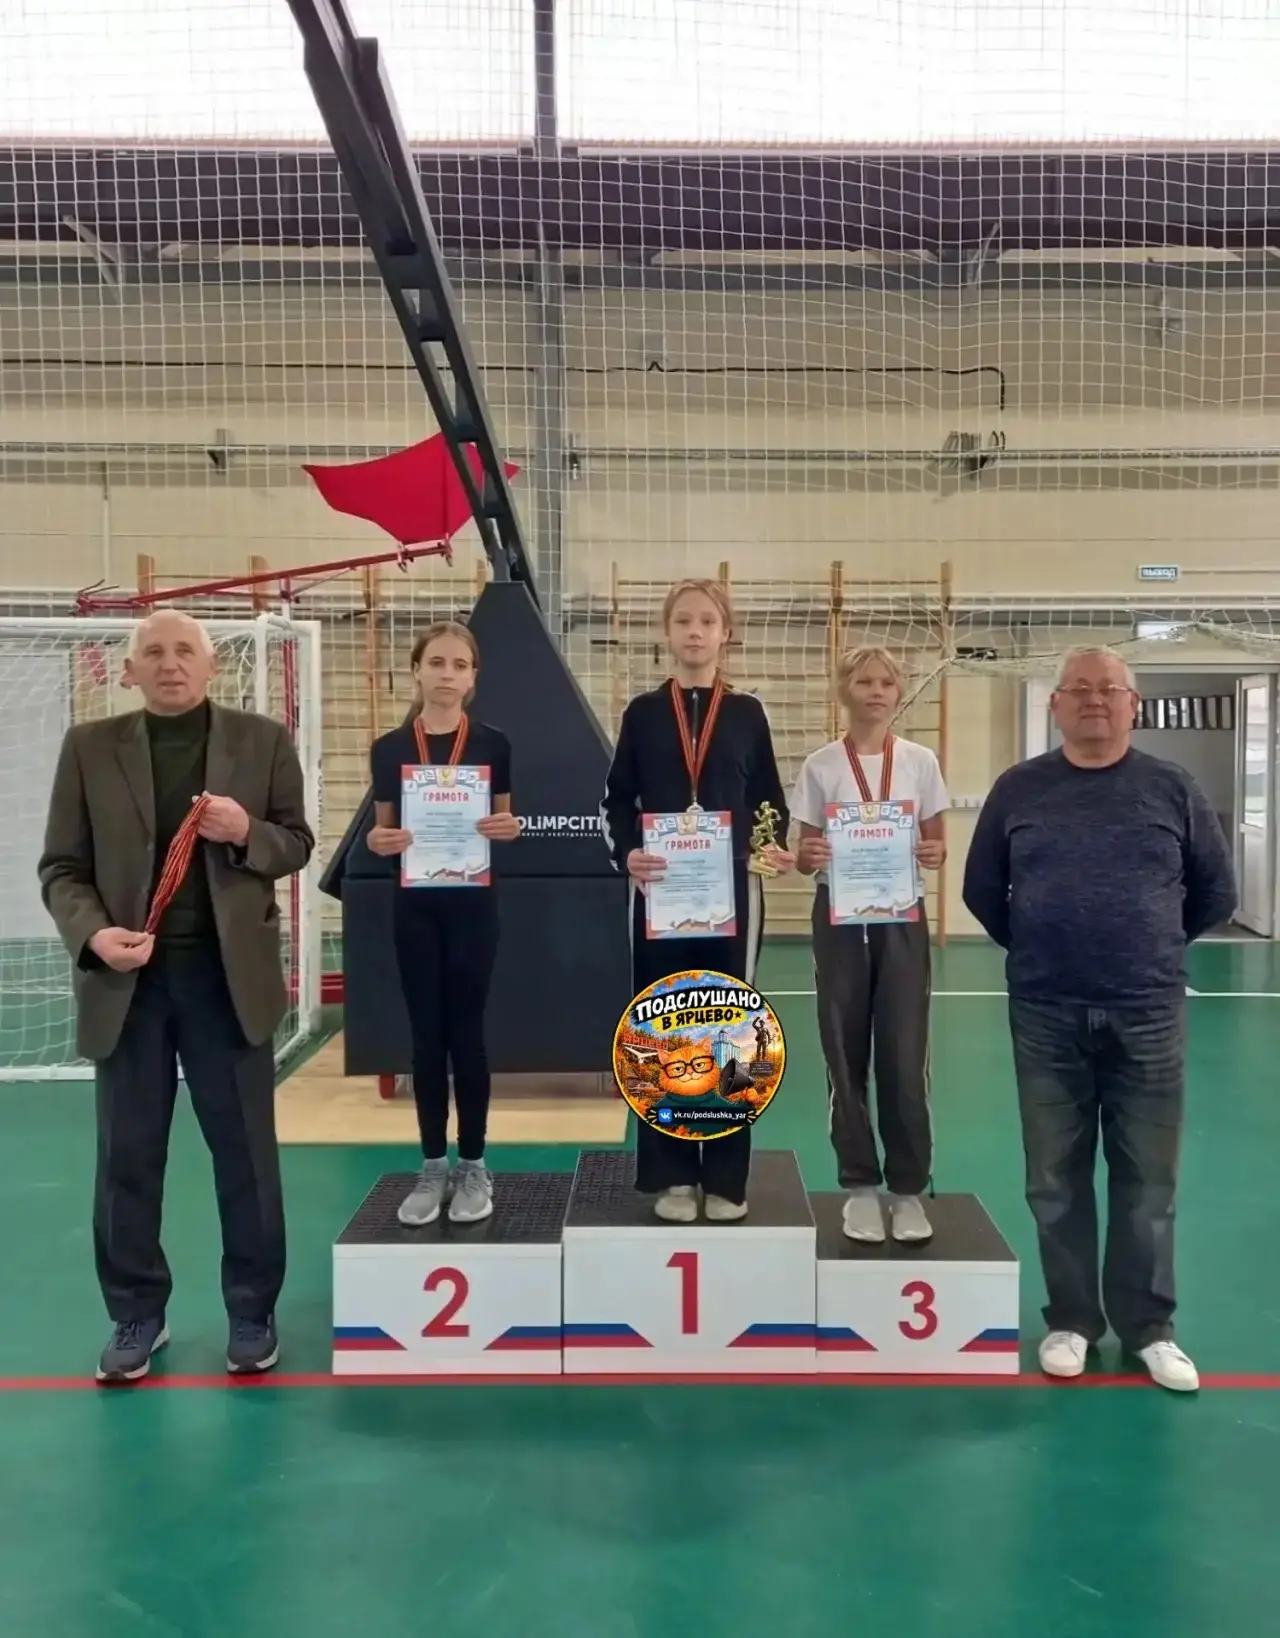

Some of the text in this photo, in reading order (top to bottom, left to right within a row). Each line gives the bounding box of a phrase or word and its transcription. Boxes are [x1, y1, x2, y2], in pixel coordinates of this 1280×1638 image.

[423, 792, 470, 802] ГРАМОТА
[665, 839, 711, 850] ГРАМОТА
[848, 828, 894, 839] ГРАМОТА
[421, 1266, 470, 1337] 2
[666, 1251, 699, 1335] 1
[898, 1281, 938, 1340] 3
